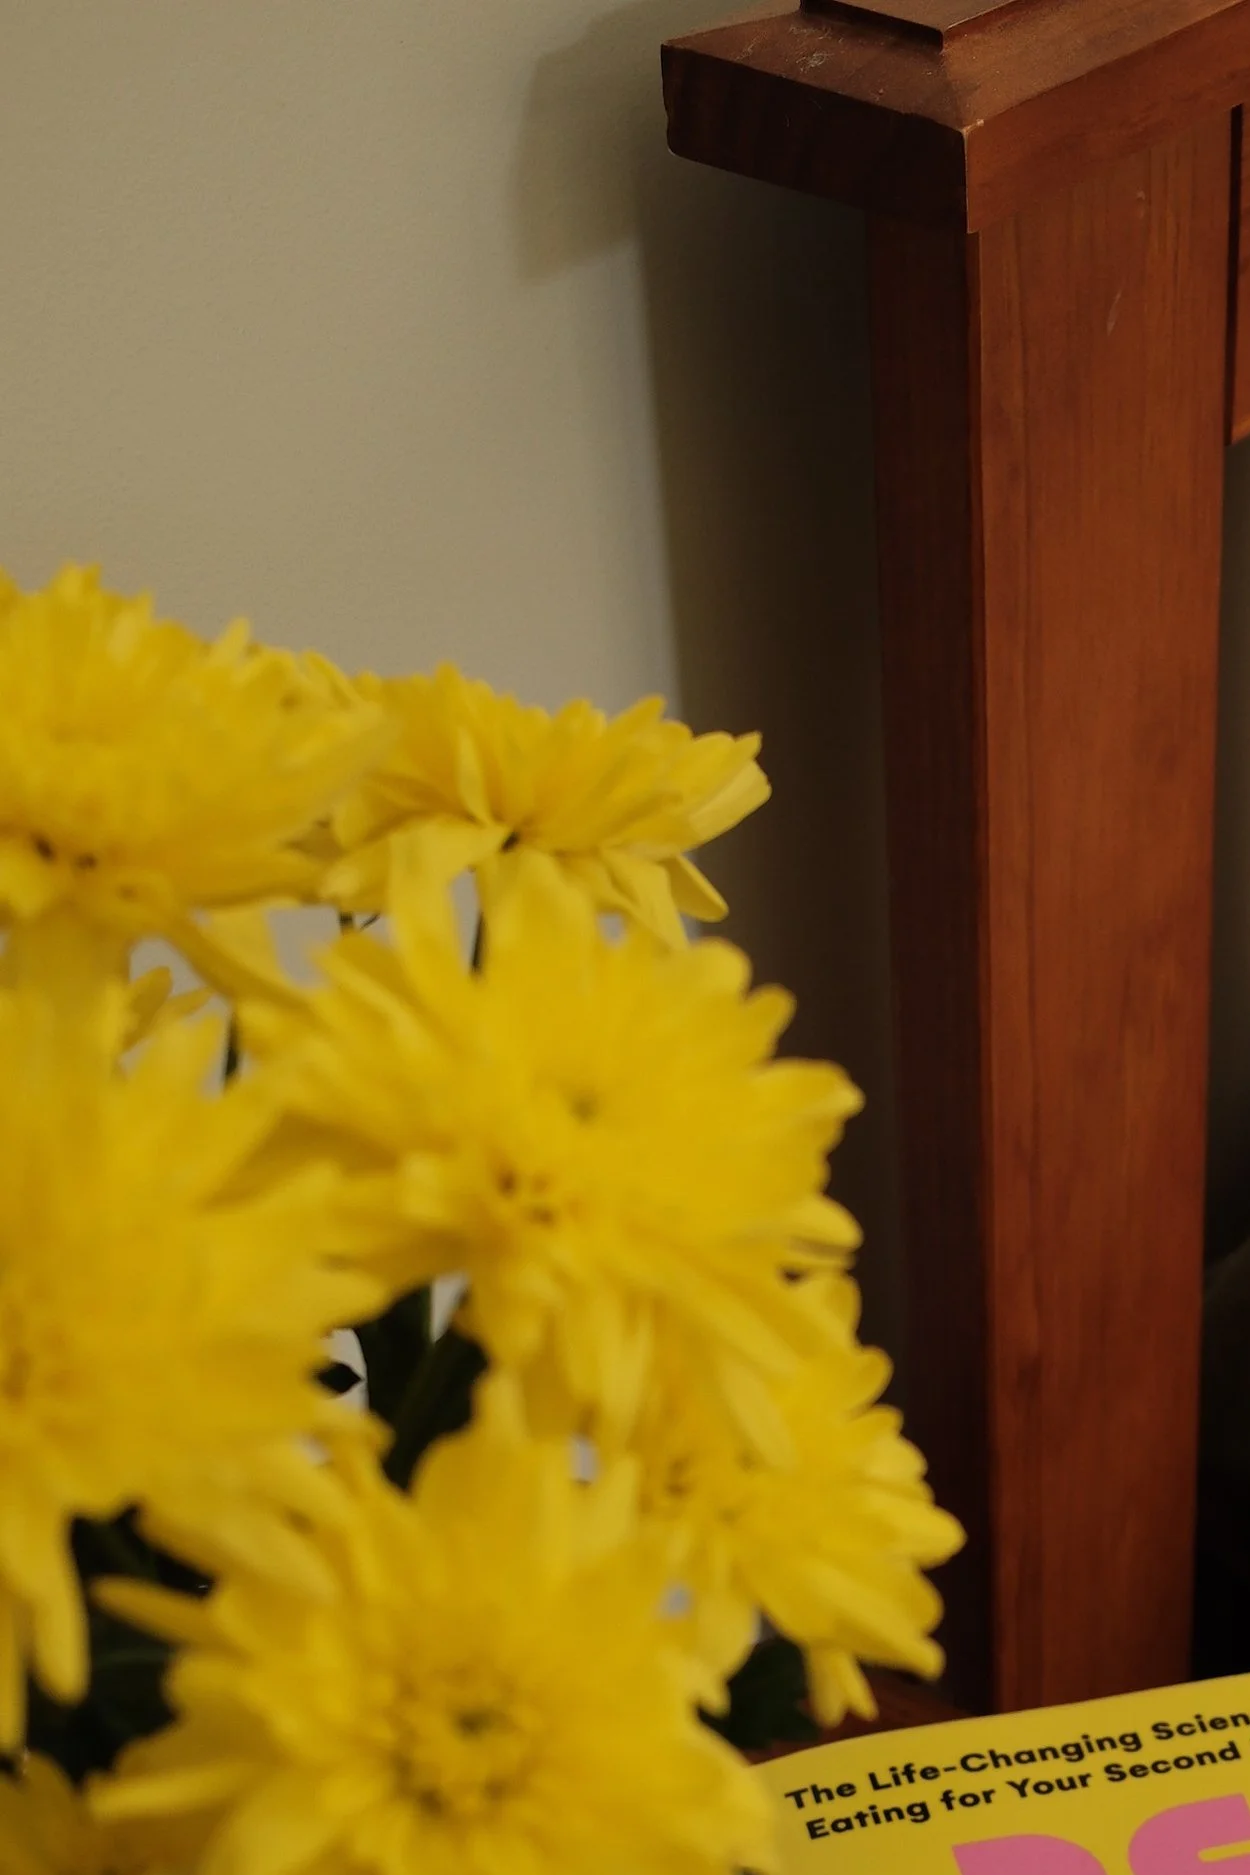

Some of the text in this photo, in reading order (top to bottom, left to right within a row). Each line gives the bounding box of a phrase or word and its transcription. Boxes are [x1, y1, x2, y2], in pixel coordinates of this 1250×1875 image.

[784, 1782, 857, 1810] The
[868, 1732, 1143, 1791] Life-Changing
[806, 1801, 931, 1840] Eating
[940, 1789, 997, 1811] for
[1006, 1771, 1093, 1799] Your
[1104, 1740, 1242, 1782] Second
